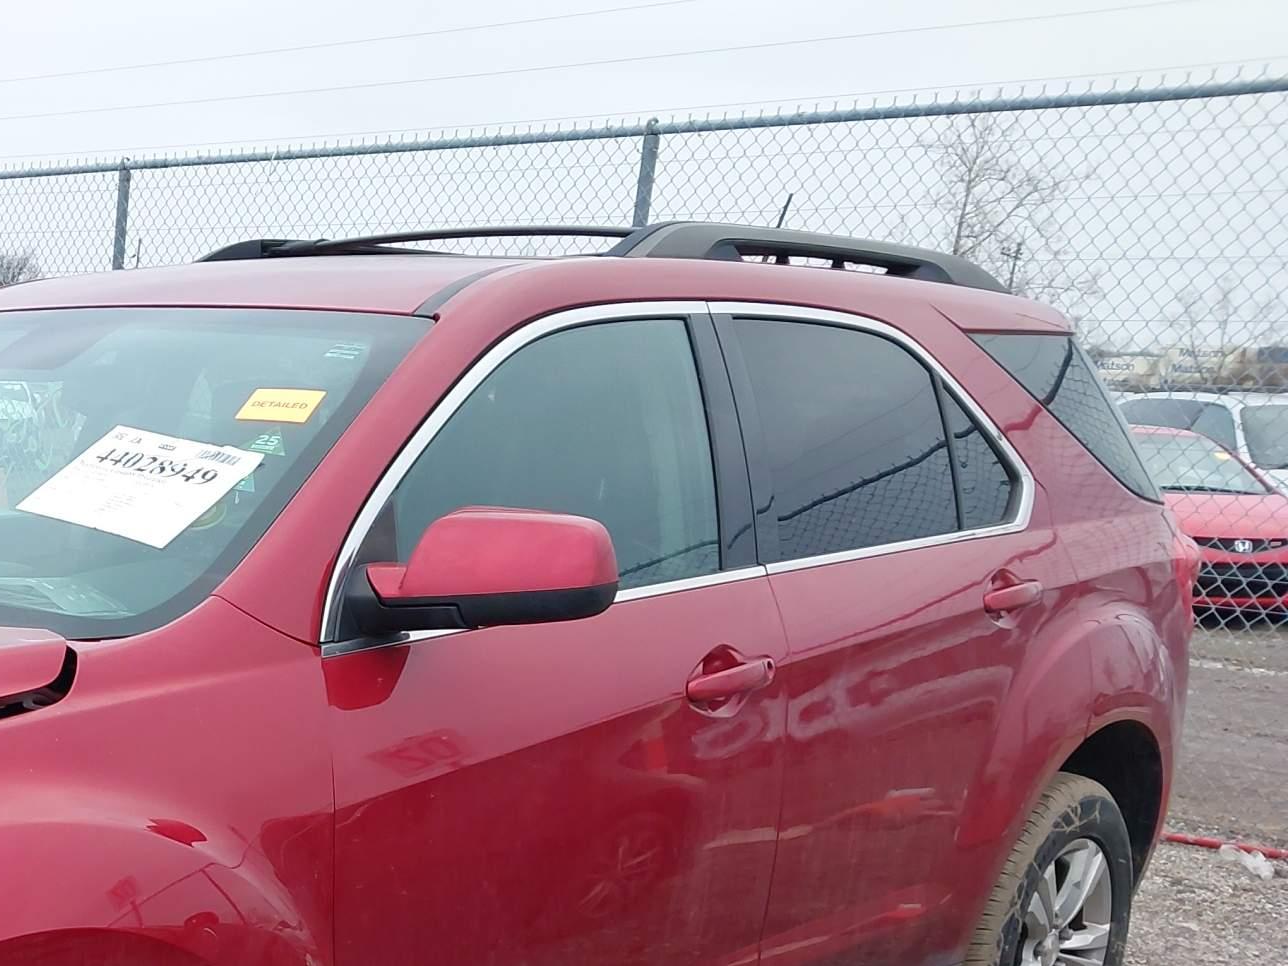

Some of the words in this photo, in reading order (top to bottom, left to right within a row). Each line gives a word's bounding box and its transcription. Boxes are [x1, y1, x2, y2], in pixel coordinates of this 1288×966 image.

[250, 400, 309, 410] DETAILED
[254, 434, 281, 446] 25
[95, 448, 219, 485] 44028949
